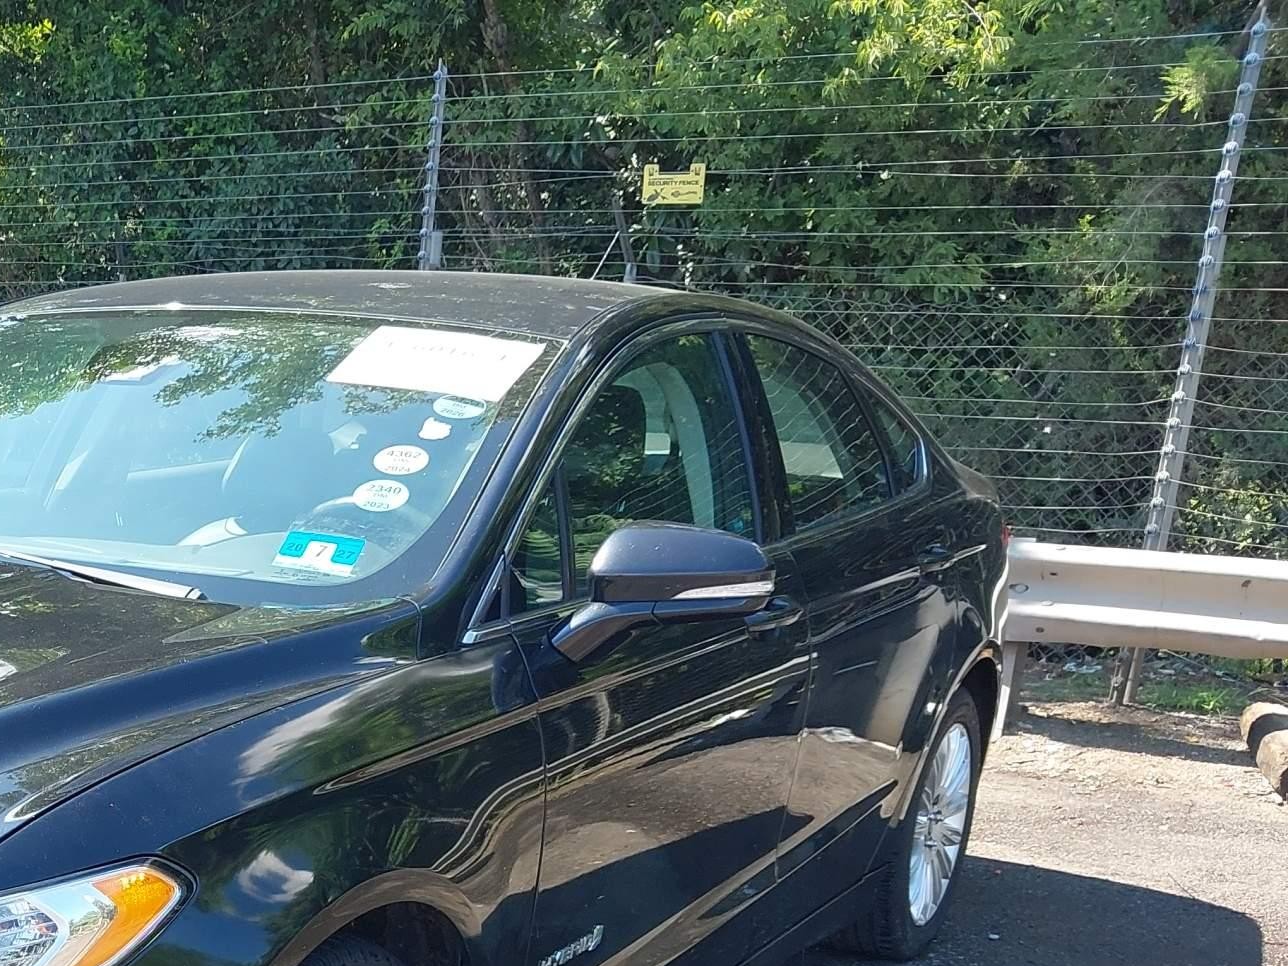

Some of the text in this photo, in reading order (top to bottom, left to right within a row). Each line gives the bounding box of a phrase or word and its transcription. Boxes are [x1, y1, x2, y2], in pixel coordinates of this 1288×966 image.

[286, 542, 355, 561] 20 7 27
